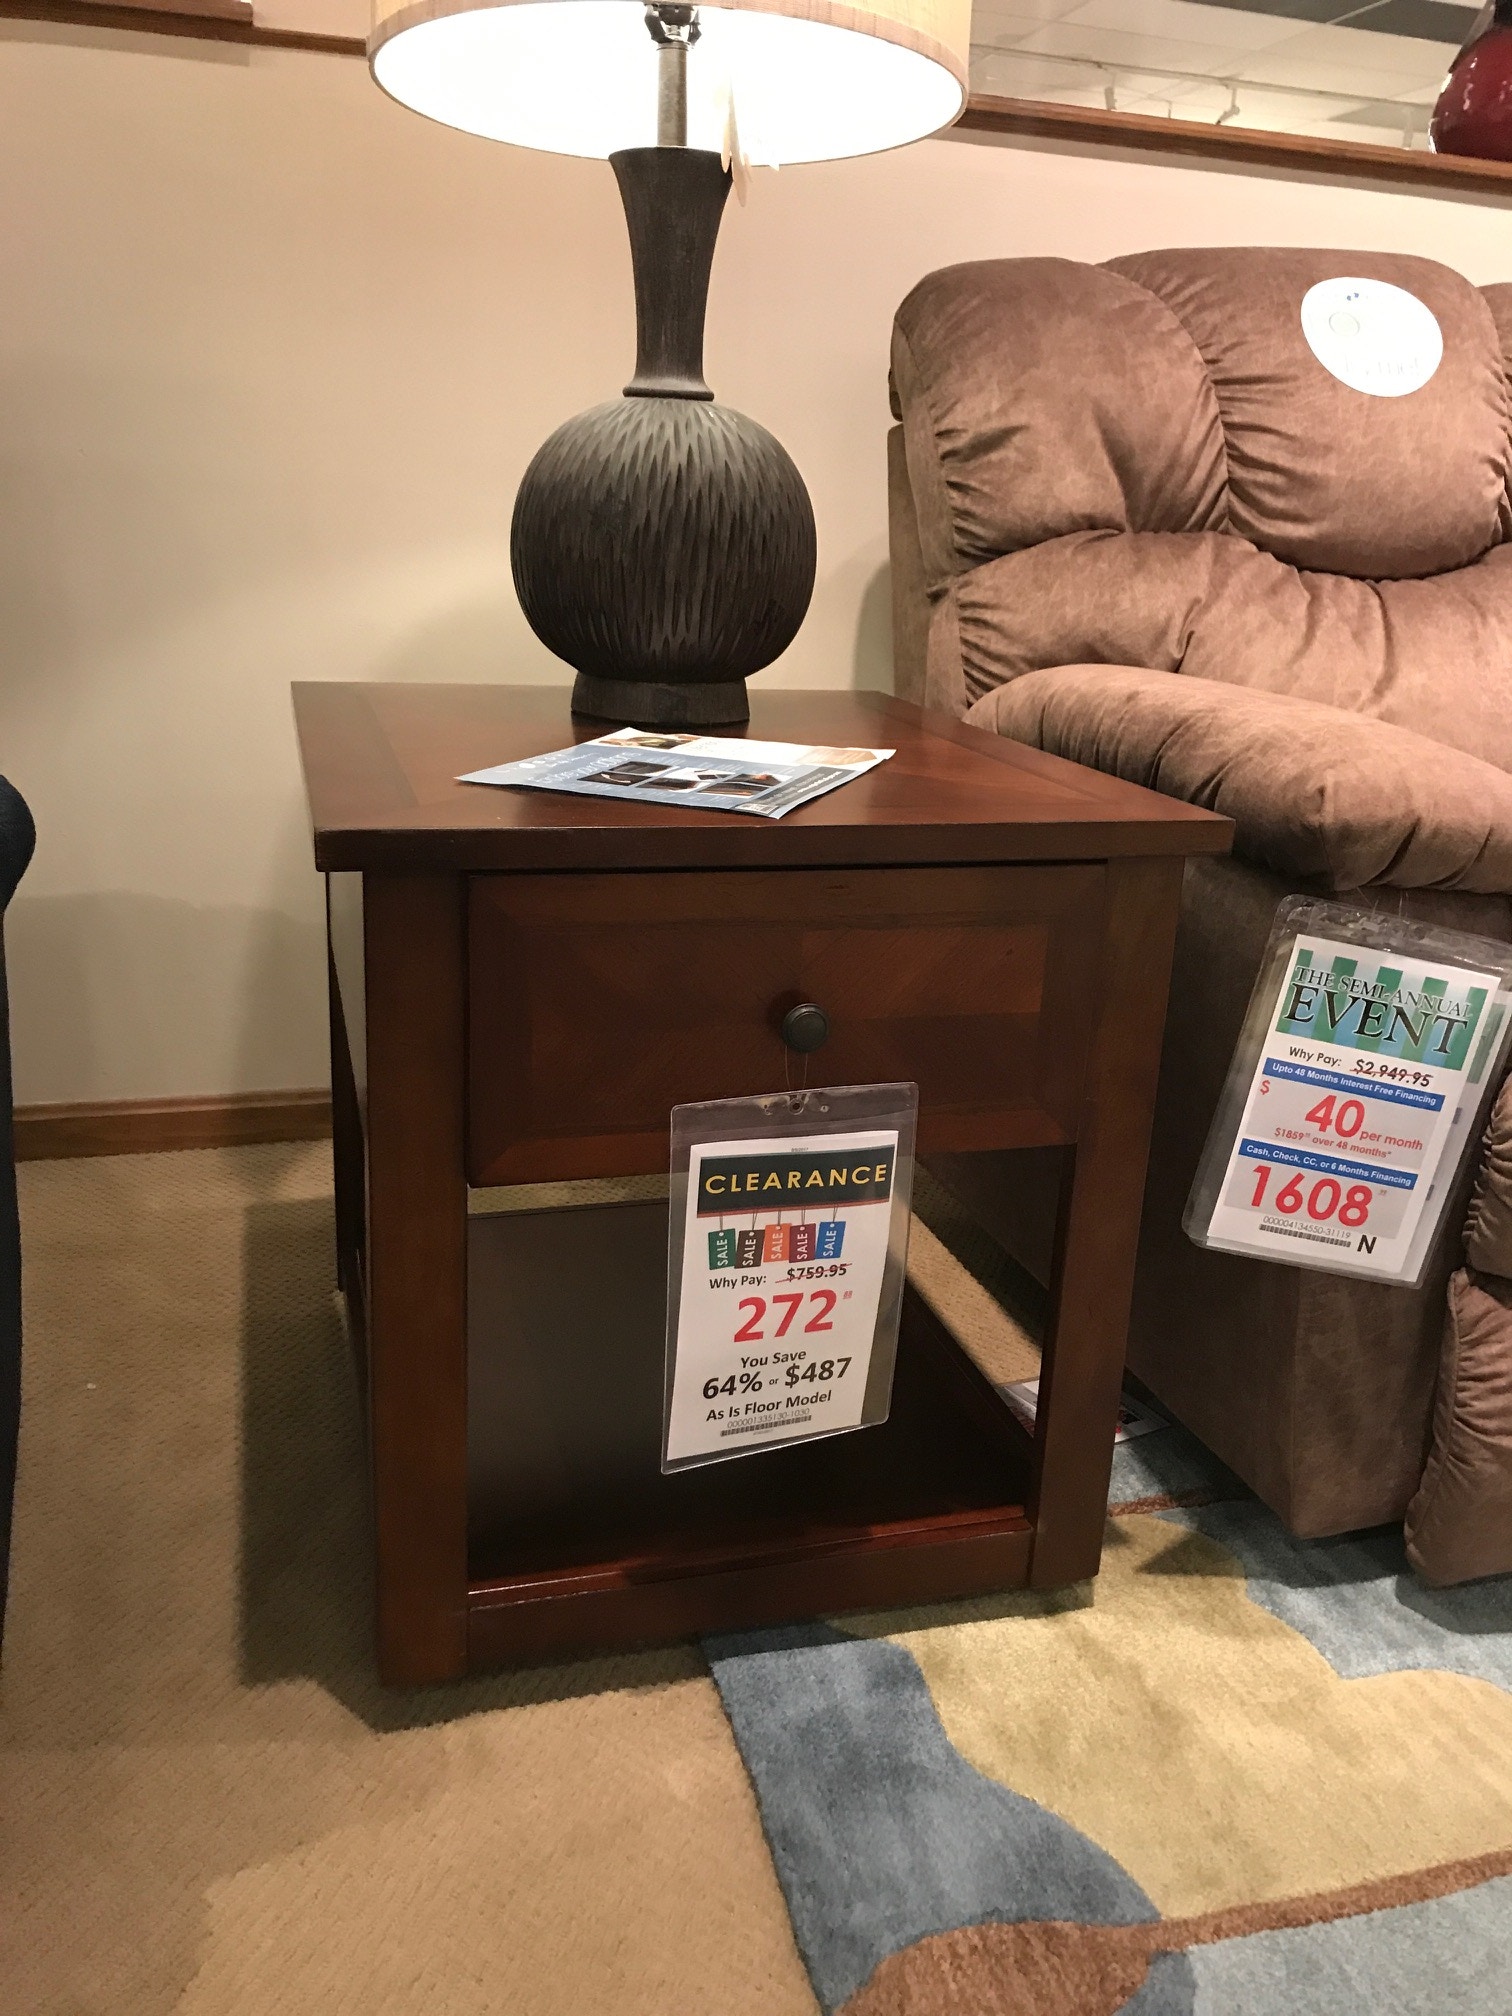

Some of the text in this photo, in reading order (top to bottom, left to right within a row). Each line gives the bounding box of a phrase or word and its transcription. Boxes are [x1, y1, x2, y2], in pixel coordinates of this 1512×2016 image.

[1294, 965, 1474, 1018] THE SEMI-ANNUAL
[1283, 981, 1469, 1055] EVENT
[1289, 1046, 1431, 1087] Why Pay: $2,949.95
[1260, 1079, 1271, 1095] $
[1272, 1062, 1437, 1106] Upto 48 Months Interest Free Financing
[1305, 1094, 1423, 1150] 40 per month
[1312, 1137, 1334, 1147] over
[1335, 1140, 1348, 1150] 48
[705, 1164, 887, 1194] CLEARANCE
[1246, 1144, 1412, 1186] Cash, Check, CC, or 6 Months Financing
[1251, 1165, 1373, 1227] 1608
[716, 1238, 729, 1268] SALE
[742, 1237, 757, 1267] SALE
[771, 1230, 784, 1260] SALE
[797, 1232, 808, 1260] SALE
[823, 1229, 838, 1257] SALE
[1357, 1234, 1377, 1254] N
[709, 1263, 847, 1289] Why Pay: $759.95
[733, 1289, 837, 1343] 272
[741, 1351, 807, 1369] You Save
[702, 1357, 852, 1400] 64% or $487
[706, 1390, 832, 1422] As Is Floor Model
